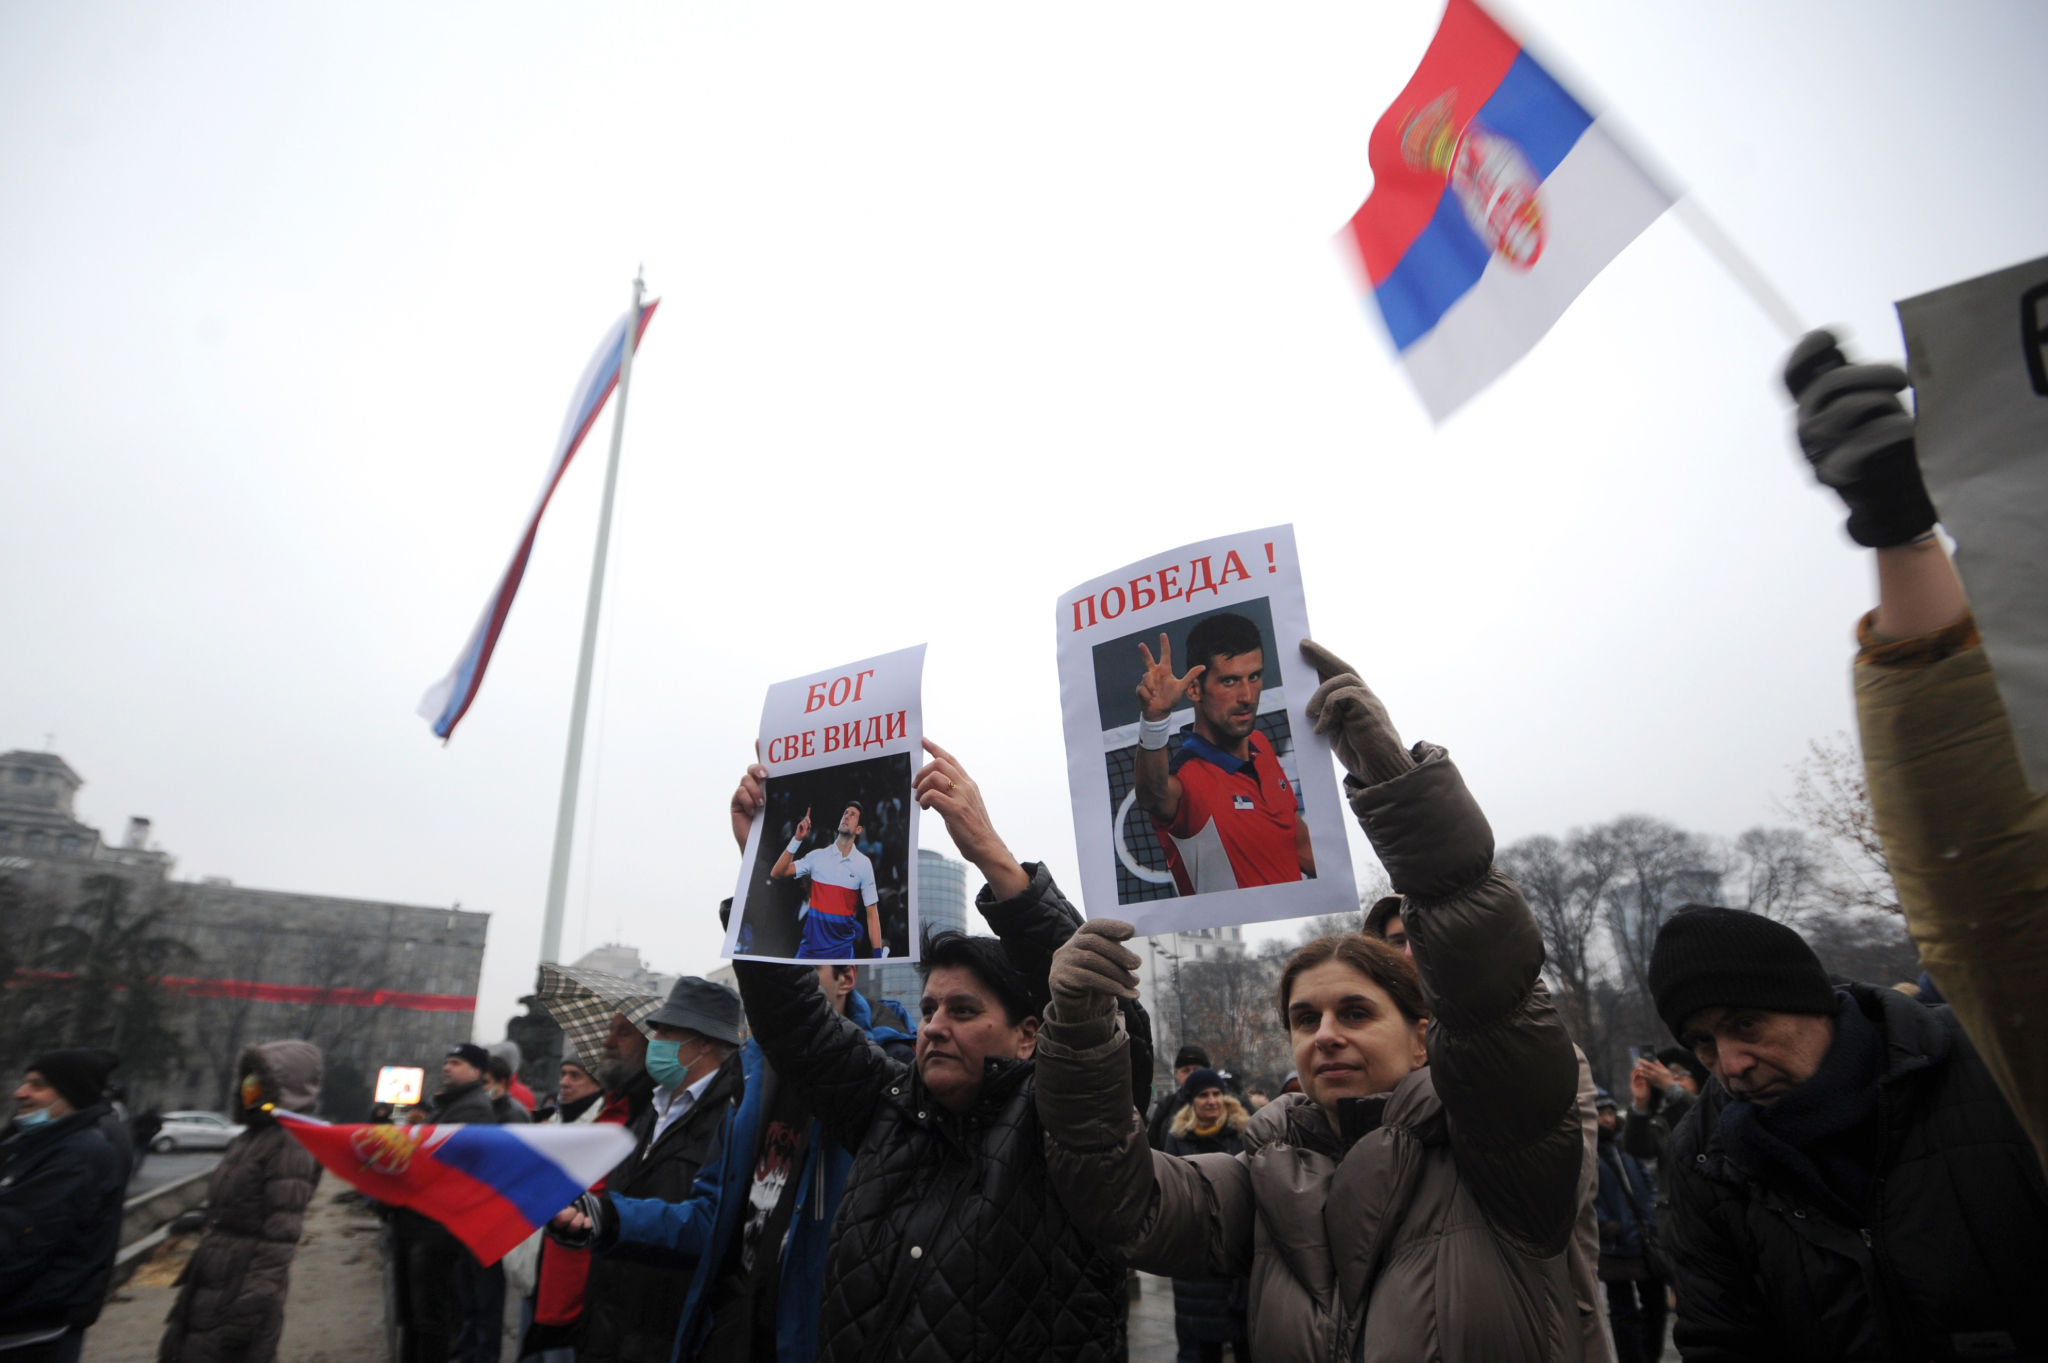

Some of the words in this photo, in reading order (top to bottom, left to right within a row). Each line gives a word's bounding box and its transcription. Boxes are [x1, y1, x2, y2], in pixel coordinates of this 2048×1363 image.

[1072, 549, 1252, 632] ПОБЕДА
[1264, 542, 1278, 574] !
[803, 669, 875, 714] БОГ
[768, 730, 816, 764] СВЕ
[823, 710, 907, 752] ВИДИ
